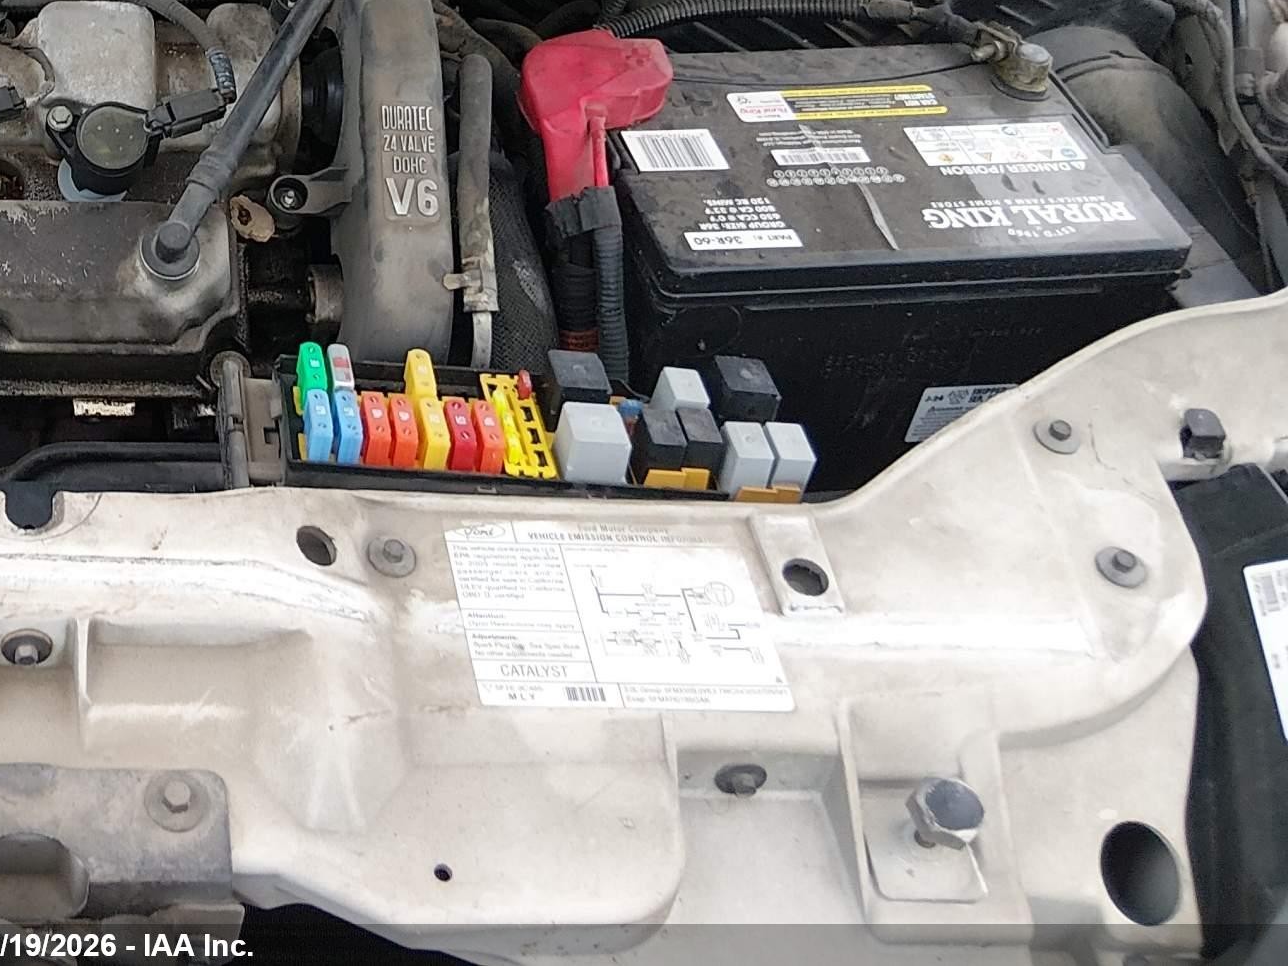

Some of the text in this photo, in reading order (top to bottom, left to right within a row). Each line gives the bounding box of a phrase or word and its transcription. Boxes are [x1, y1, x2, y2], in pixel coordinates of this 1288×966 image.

[381, 105, 434, 131] DURATEC
[383, 134, 435, 153] 24 VALVE
[393, 156, 428, 174] DOHC
[385, 177, 439, 216] V6
[1014, 197, 1045, 206] FARM
[1048, 195, 1105, 205] AMERICA'S
[929, 199, 967, 209] STORE
[968, 198, 1000, 208] HOME
[921, 201, 1137, 229] RURAL KING
[748, 221, 787, 229] GROUP
[694, 236, 743, 245] 36R-60
[527, 532, 564, 541] VEHICLE
[567, 533, 613, 542] EMISSION
[615, 534, 658, 543] CONTROL
[500, 664, 568, 677] CATALYST
